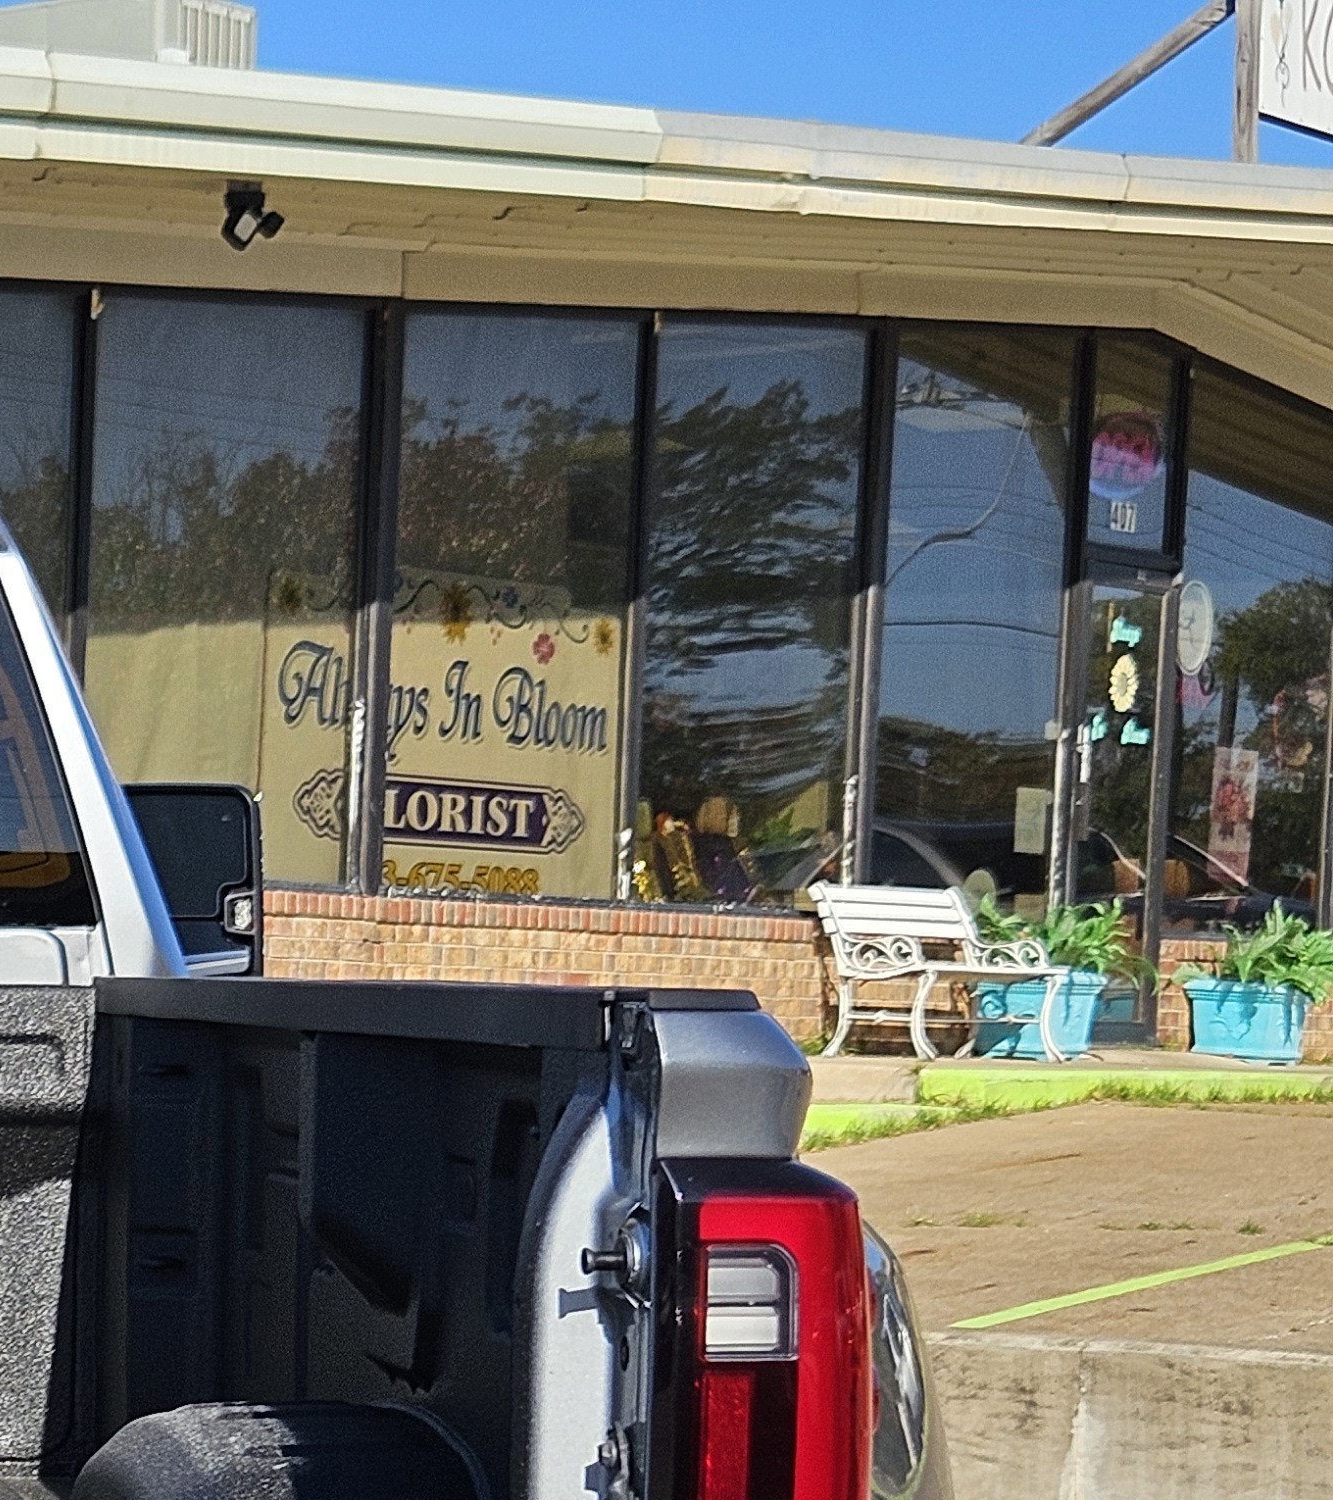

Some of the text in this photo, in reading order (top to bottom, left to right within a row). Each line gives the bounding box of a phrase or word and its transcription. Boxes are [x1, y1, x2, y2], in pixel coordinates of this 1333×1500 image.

[278, 640, 608, 762] Alys In Bloom
[383, 789, 534, 838] LORIST
